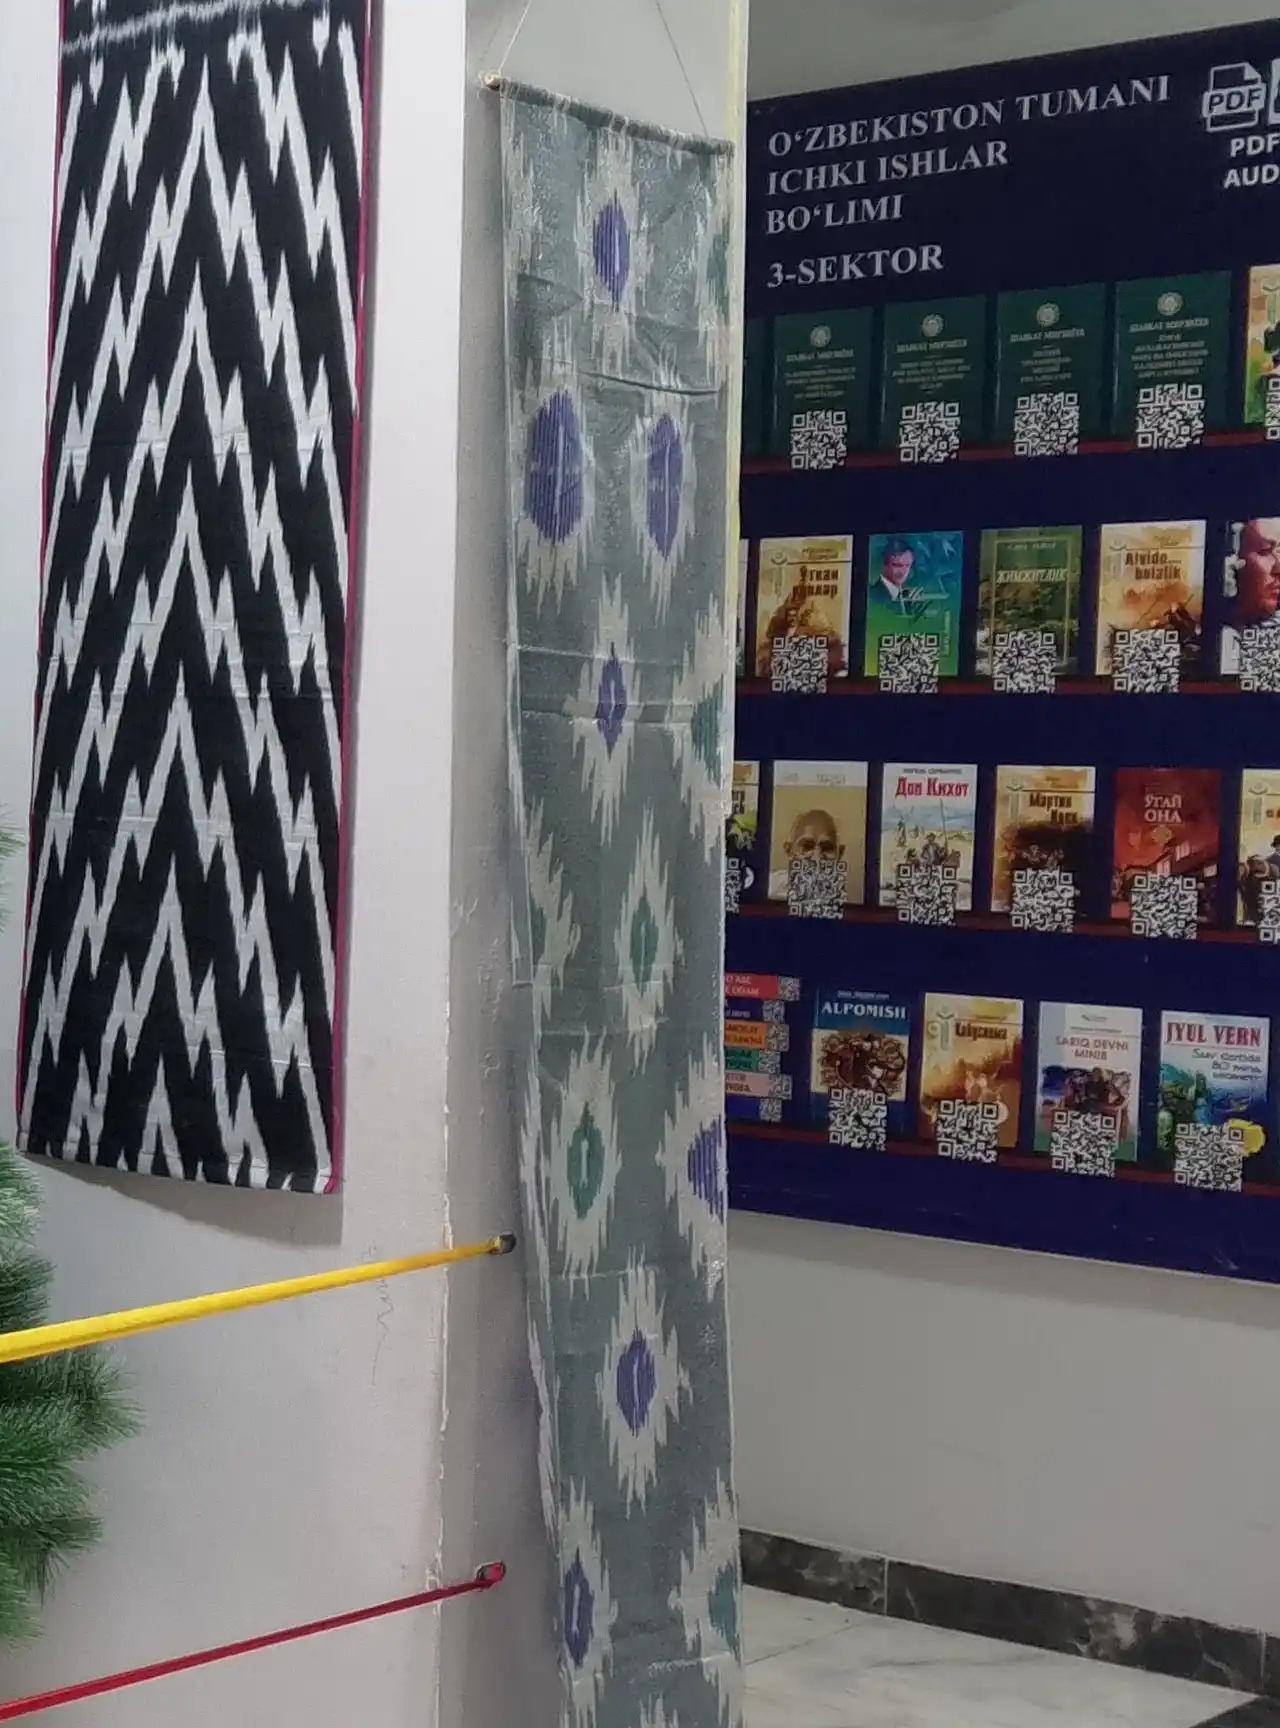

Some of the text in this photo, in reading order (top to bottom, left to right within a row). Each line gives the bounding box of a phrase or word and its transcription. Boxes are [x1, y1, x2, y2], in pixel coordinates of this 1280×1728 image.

[769, 75, 1168, 156] O‘ZBEKISTON TUMANI
[1209, 88, 1262, 112] PDF
[768, 141, 1008, 195] ICHKI ISHLAR
[767, 195, 902, 234] BO‘LIMI
[767, 245, 943, 288] 3-SEKTOR
[895, 777, 969, 798] Дон Кихот
[1144, 810, 1182, 824] ОНА
